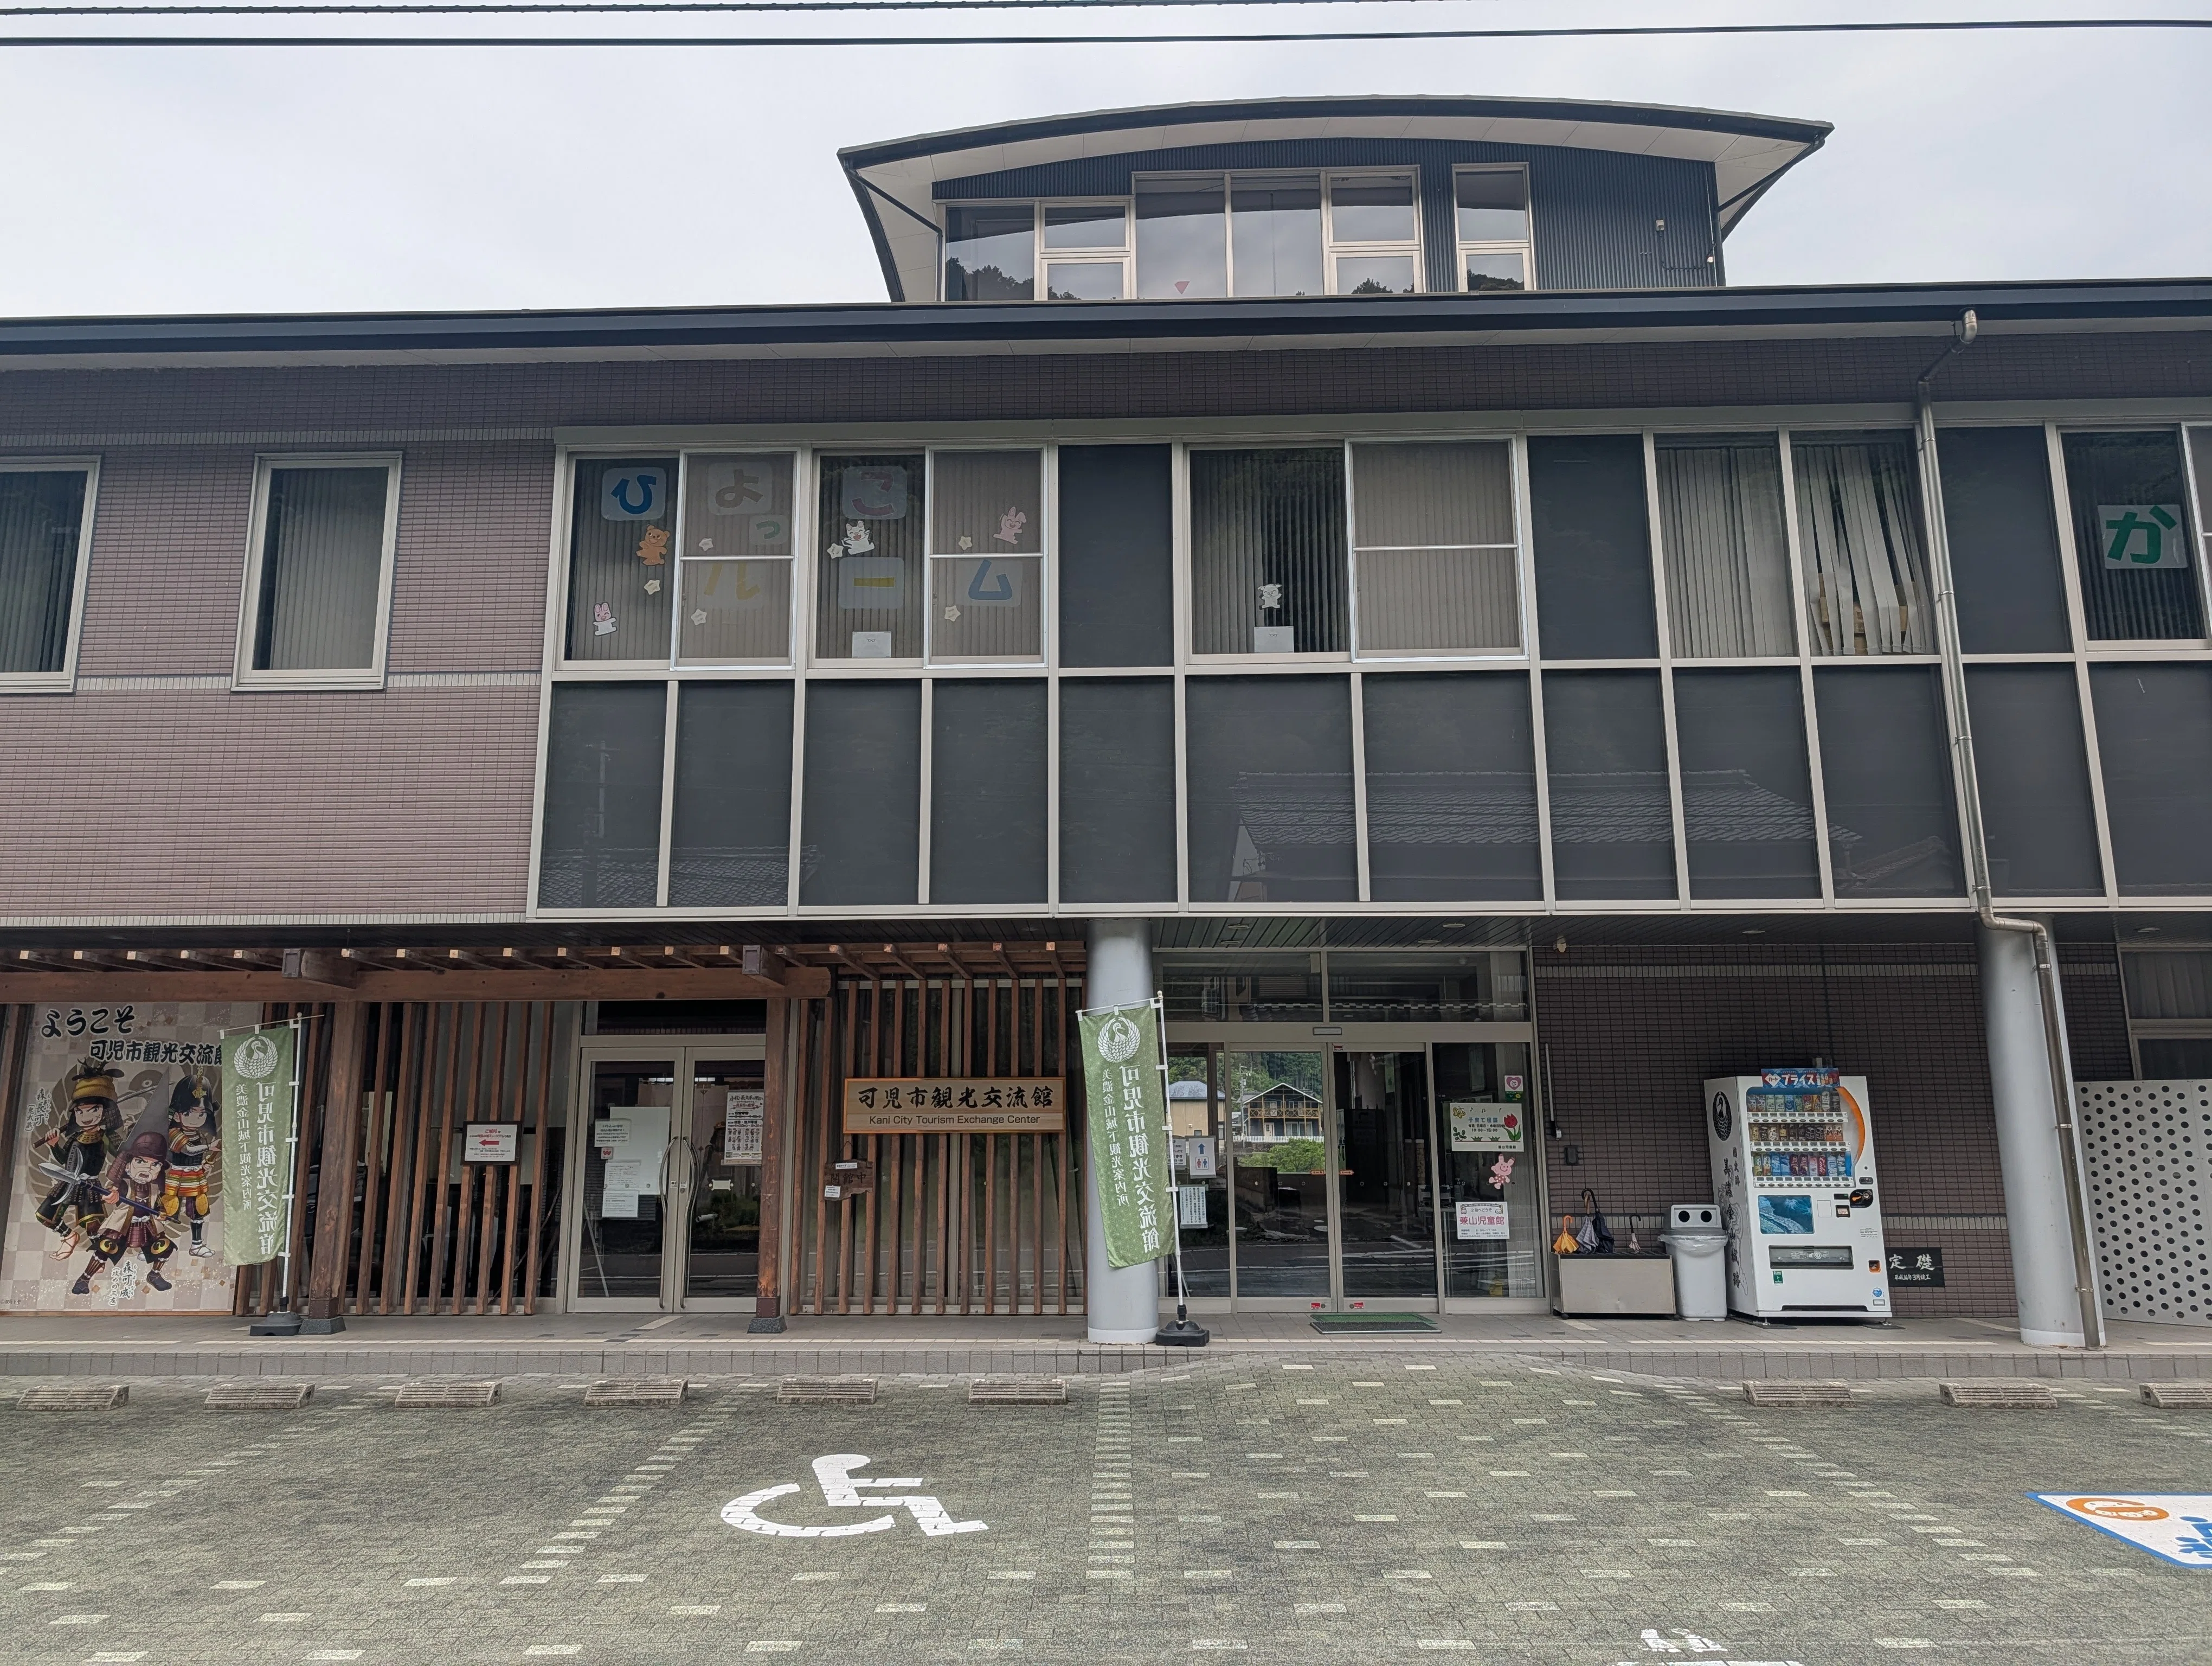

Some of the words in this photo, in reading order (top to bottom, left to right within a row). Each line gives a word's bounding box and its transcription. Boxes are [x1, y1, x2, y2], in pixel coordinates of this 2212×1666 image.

[2105, 505, 2178, 565] か
[41, 1005, 134, 1038] ようこそ
[1781, 1074, 1816, 1085] プライス
[35, 1088, 47, 1126] 森長可
[858, 1085, 1054, 1109] 可児市観光交流館
[870, 1116, 890, 1124] Kani
[893, 1116, 912, 1125] City
[917, 1116, 954, 1124] Tourism
[957, 1115, 1005, 1125] Exchange
[1007, 1115, 1040, 1124] Center
[1459, 1216, 1504, 1225] 兼山児童館
[1888, 1253, 1935, 1271] 定礎
[120, 1261, 133, 1299] 森可成
